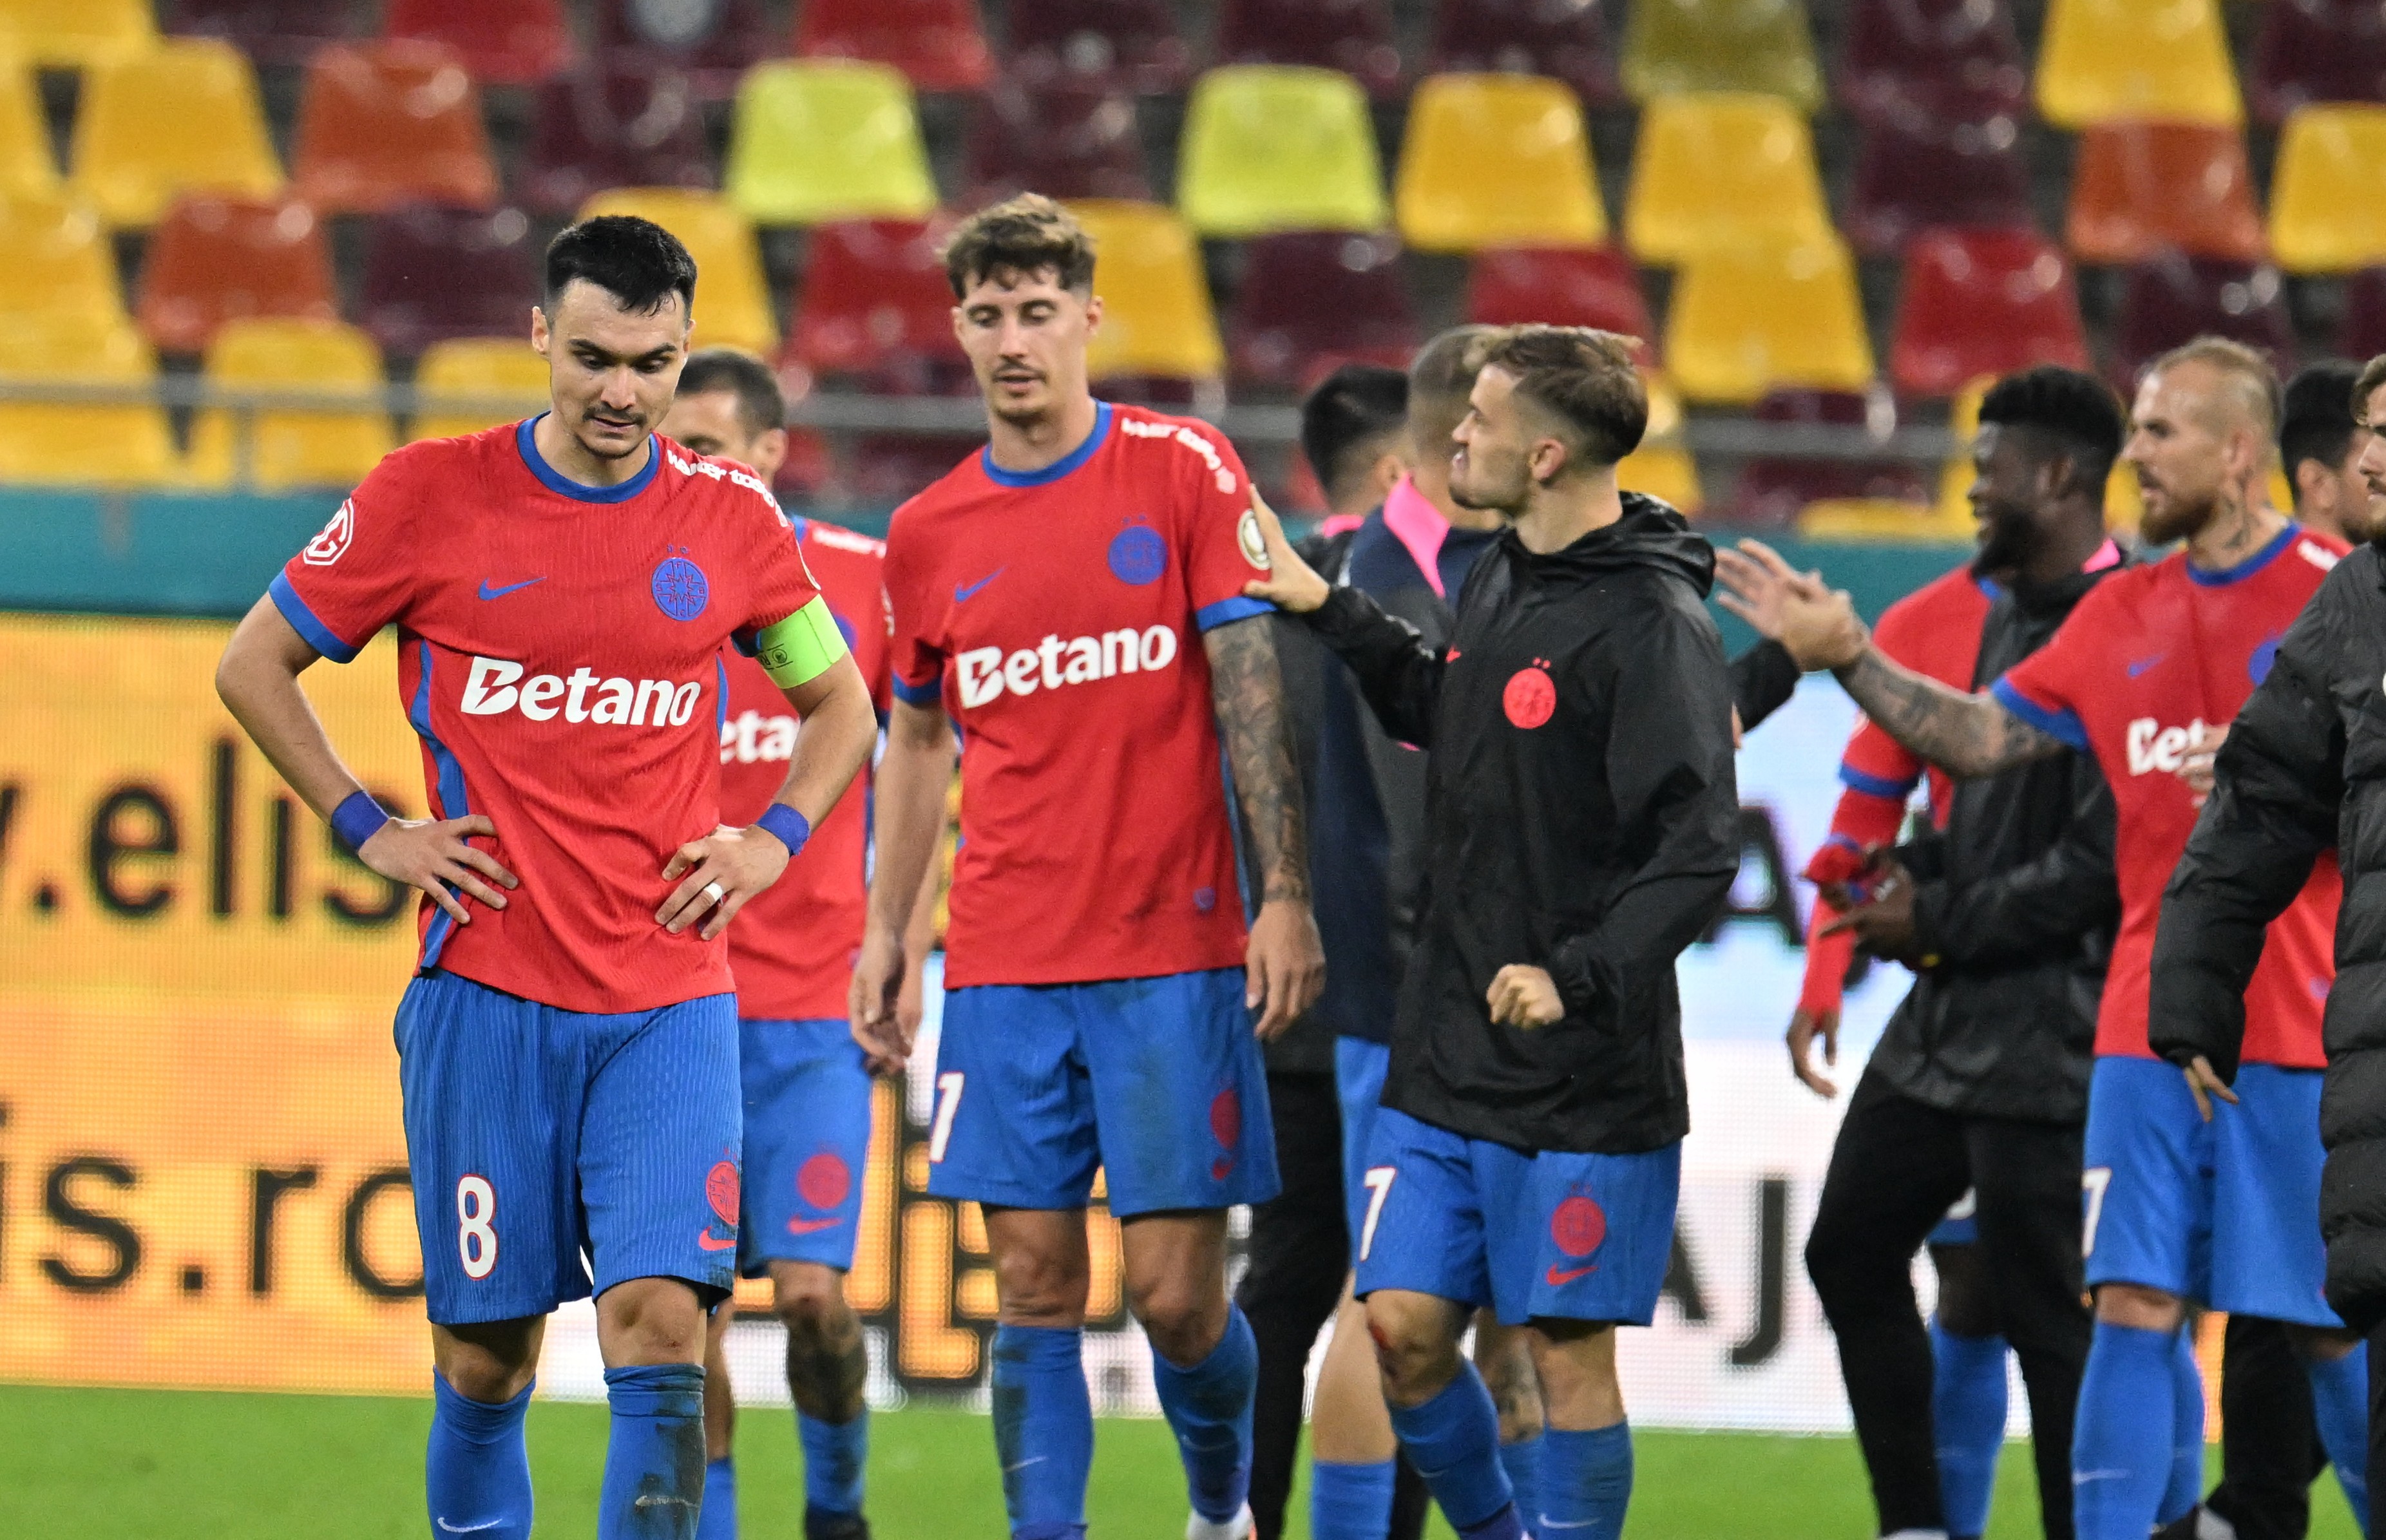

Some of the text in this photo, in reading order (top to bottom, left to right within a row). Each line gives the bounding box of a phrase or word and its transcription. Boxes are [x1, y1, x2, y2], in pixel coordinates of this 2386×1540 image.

[461, 656, 701, 727] Betano
[956, 625, 1177, 708] Betano
[455, 1174, 498, 1280] 8
[1359, 1166, 1398, 1262] 7
